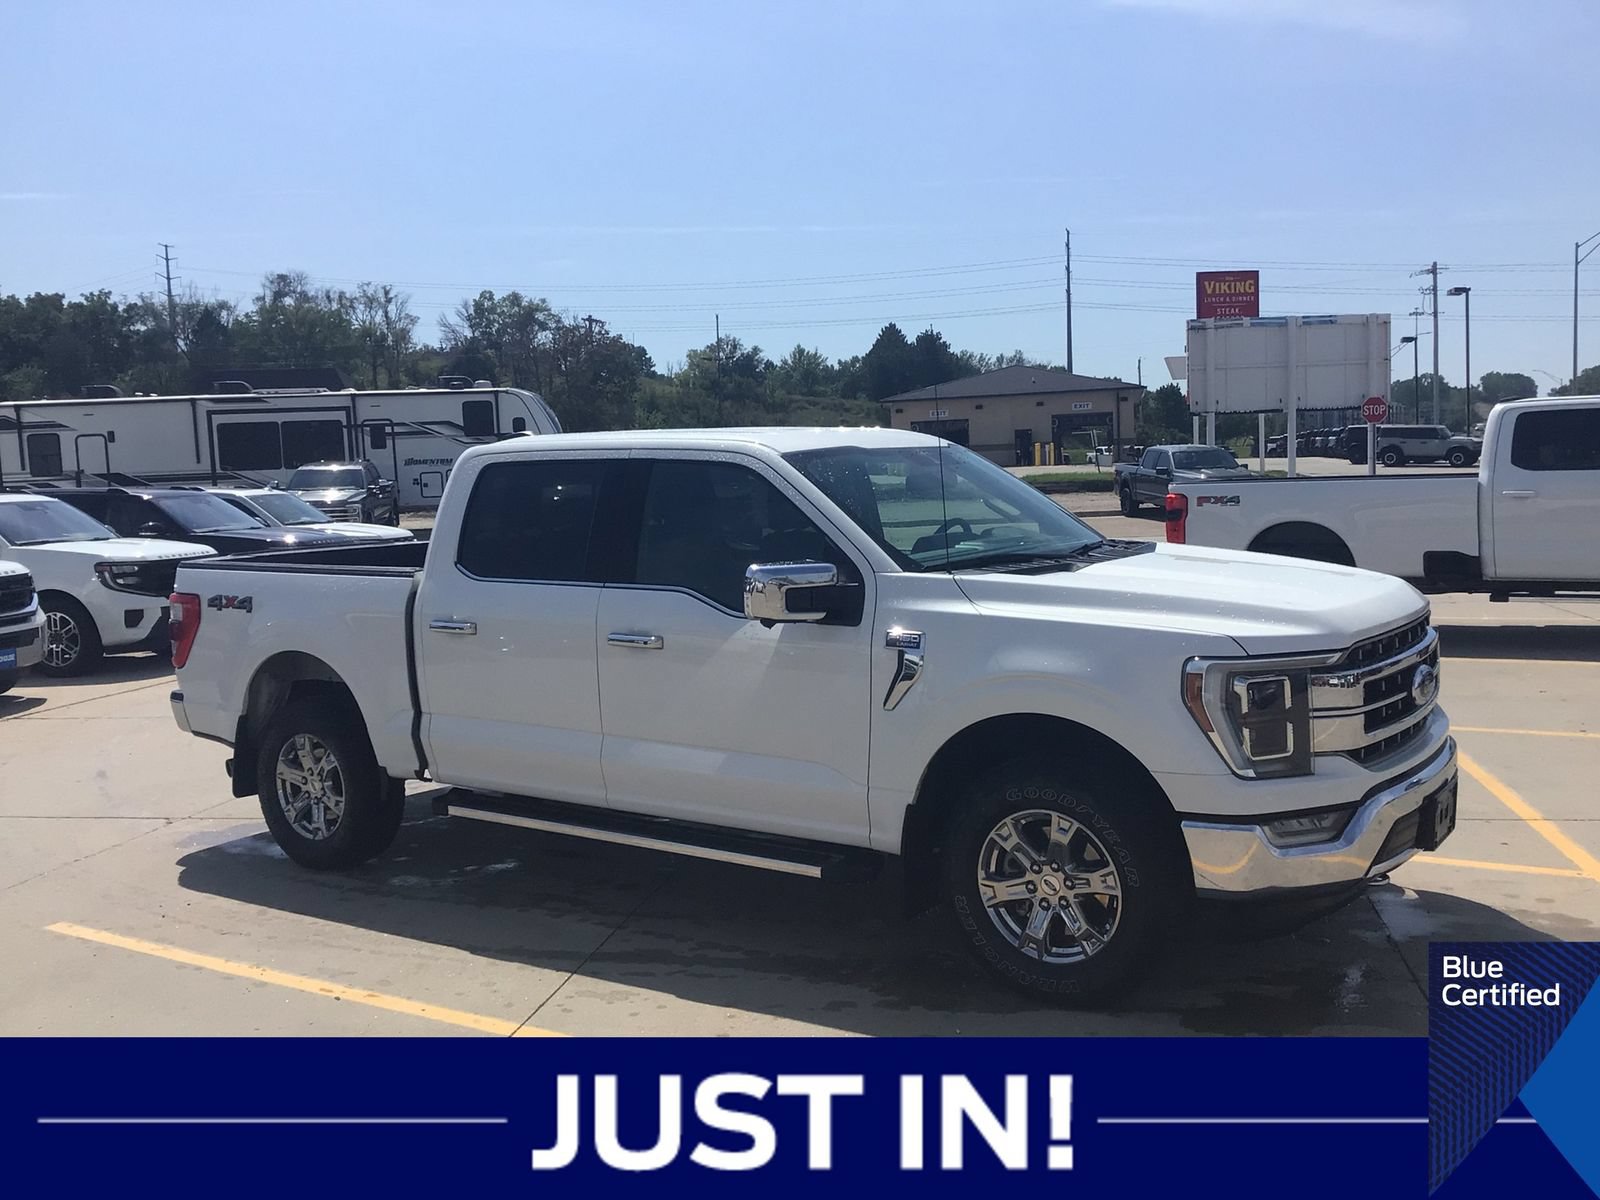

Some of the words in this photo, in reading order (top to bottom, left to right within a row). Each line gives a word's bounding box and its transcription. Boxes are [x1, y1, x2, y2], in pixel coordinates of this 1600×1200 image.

[1204, 280, 1255, 294] VIKING
[1074, 402, 1090, 410] EXIT
[1363, 404, 1386, 416] STOP
[1196, 495, 1240, 507] FX4
[1006, 786, 1140, 888] GOODYEAR
